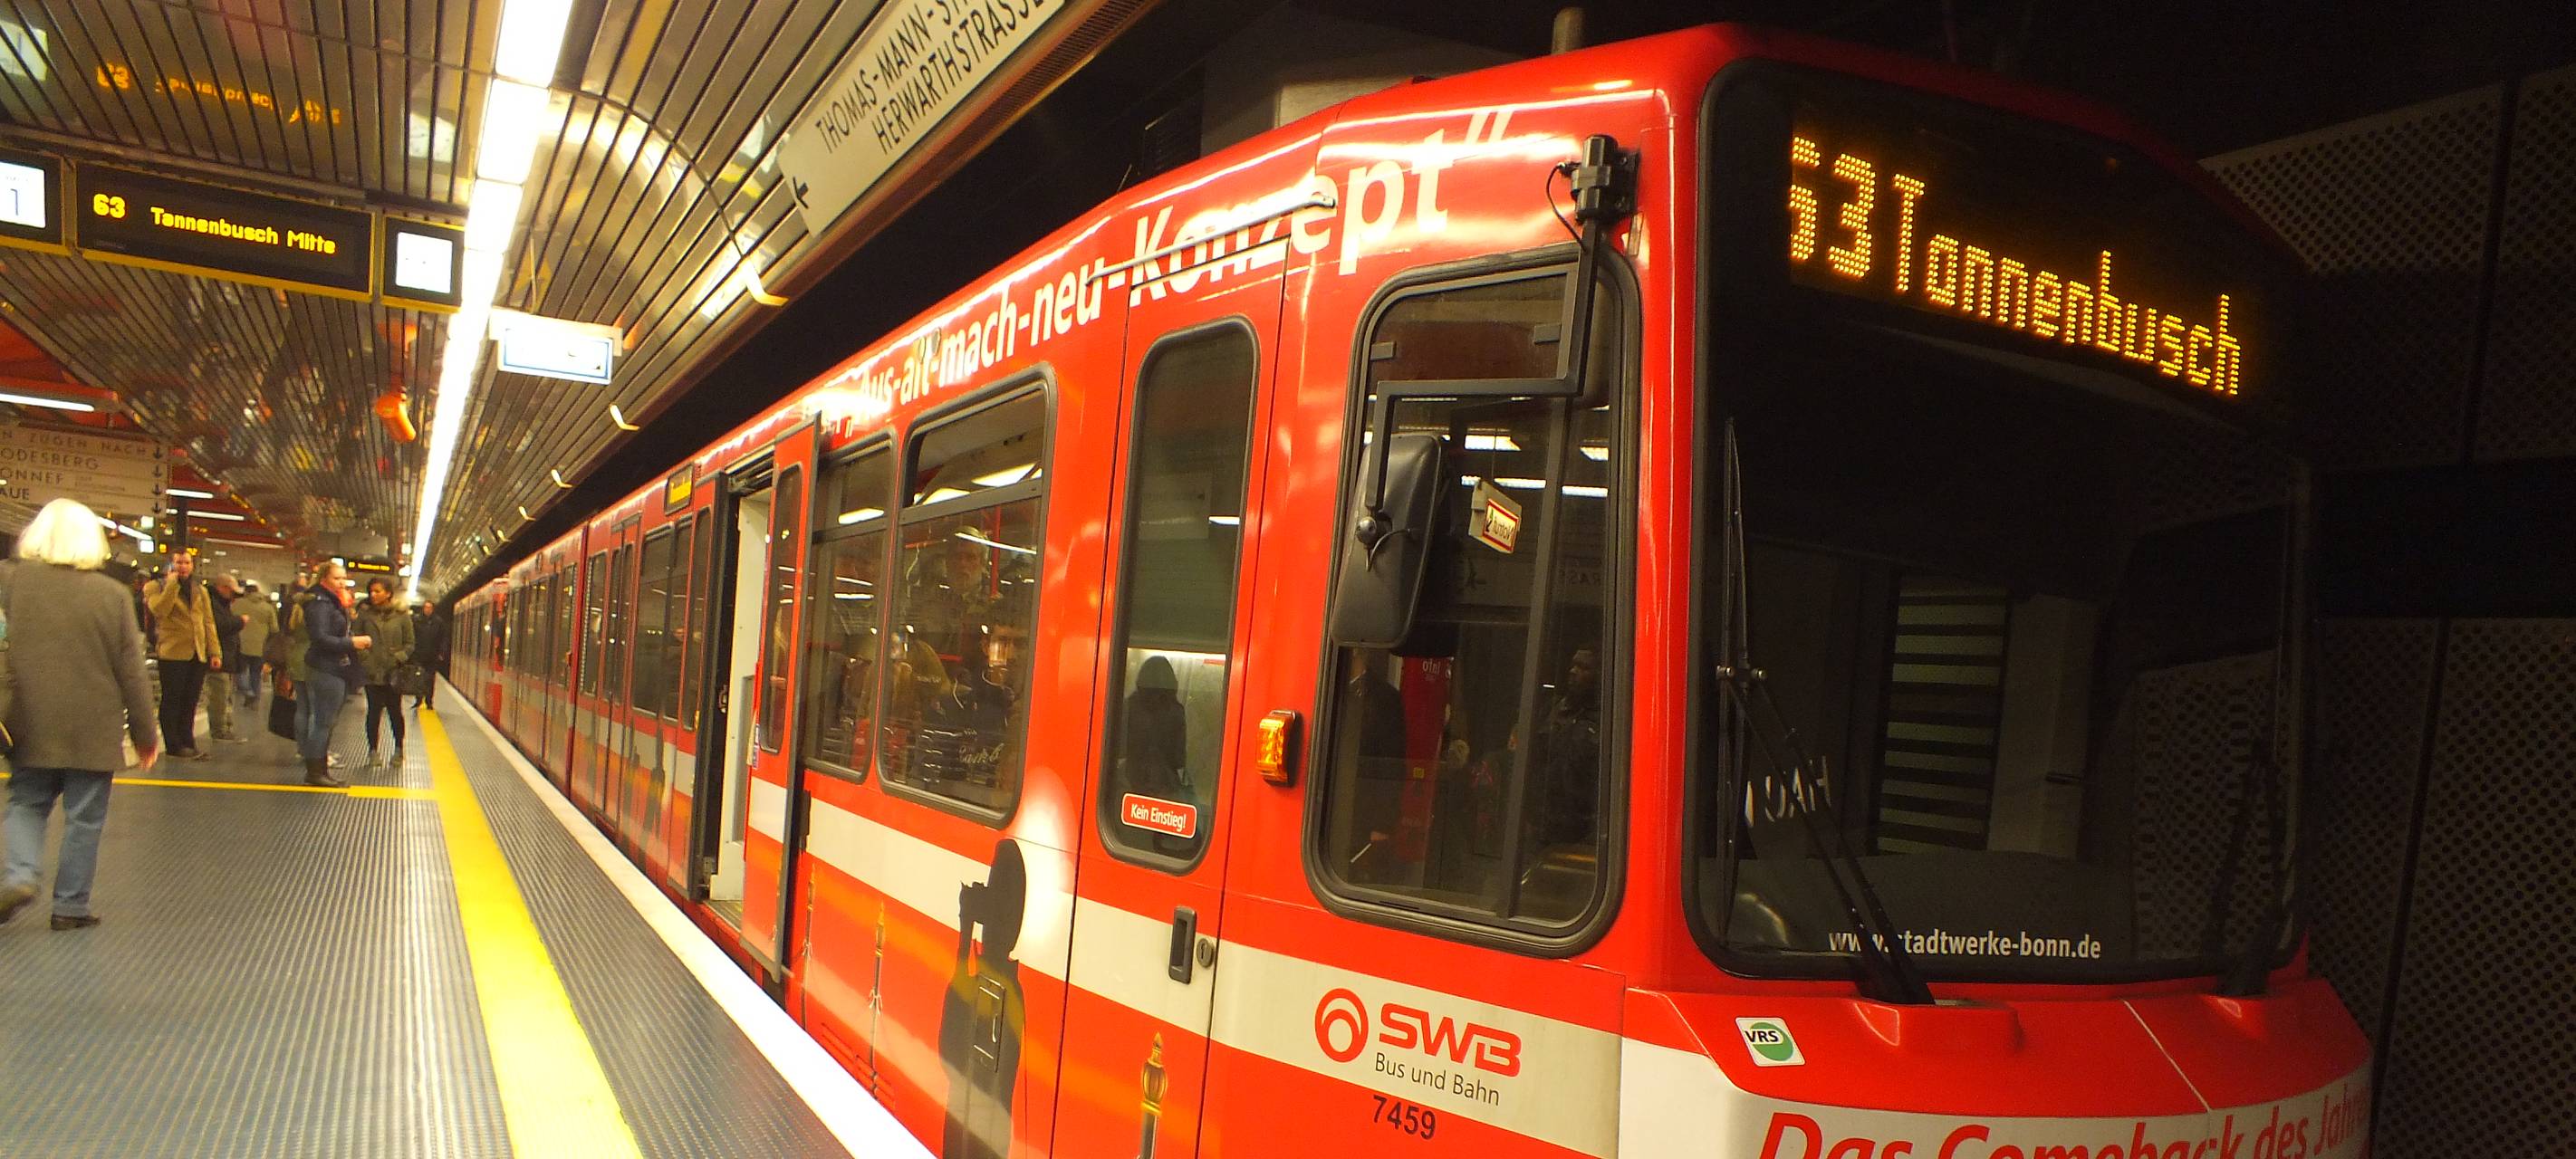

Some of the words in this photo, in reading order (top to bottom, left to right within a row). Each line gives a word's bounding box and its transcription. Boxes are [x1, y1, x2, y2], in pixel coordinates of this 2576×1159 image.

[870, 0, 1044, 156] HERWARTHSTRAS
[92, 193, 126, 218] 63
[149, 206, 279, 245] Tannenbusch
[285, 229, 336, 254] Mitte
[1891, 172, 2242, 396] Tannenbusch
[1130, 803, 1149, 822] Kein
[1149, 807, 1187, 832] Einstieg!
[1828, 927, 2101, 959] www.tadtwerke-bonn.de
[1379, 1002, 1523, 1078] SWB
[1744, 1030, 1780, 1043] VRS
[1375, 1051, 1406, 1079] Bus
[1410, 1069, 1447, 1091] und
[1452, 1073, 1500, 1106] Bahn
[1372, 1094, 1437, 1141] 7459
